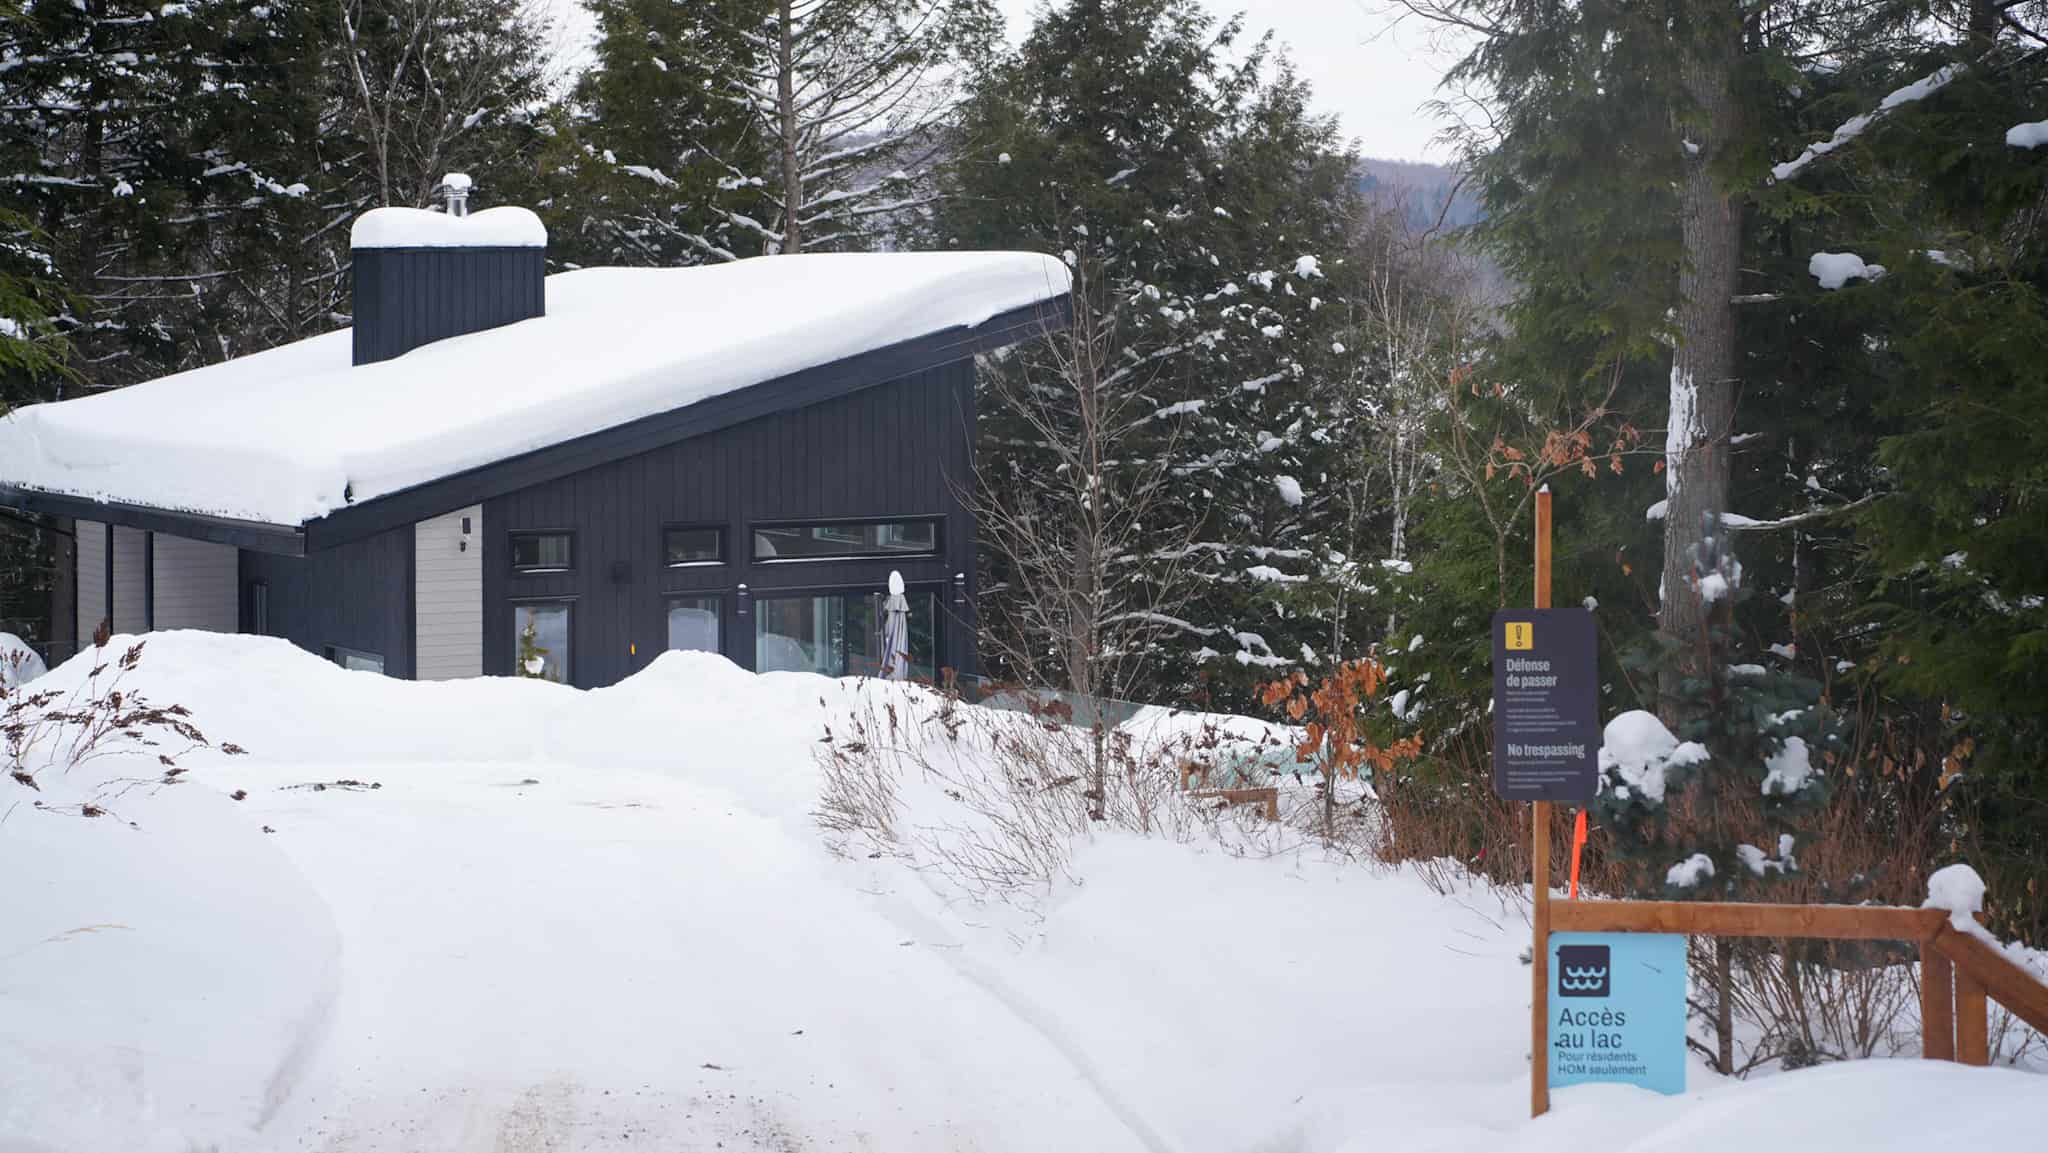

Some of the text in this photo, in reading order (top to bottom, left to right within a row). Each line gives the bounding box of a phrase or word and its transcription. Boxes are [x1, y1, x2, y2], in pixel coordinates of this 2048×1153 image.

[1506, 658, 1550, 672] Défense
[1506, 674, 1557, 689] de passer
[1507, 742, 1585, 759] No trespassing
[1558, 1007, 1625, 1027] Accès
[1559, 1029, 1622, 1048] au lac
[1558, 1051, 1638, 1061] Pour résidents
[1558, 1065, 1647, 1075] HOM seulement
